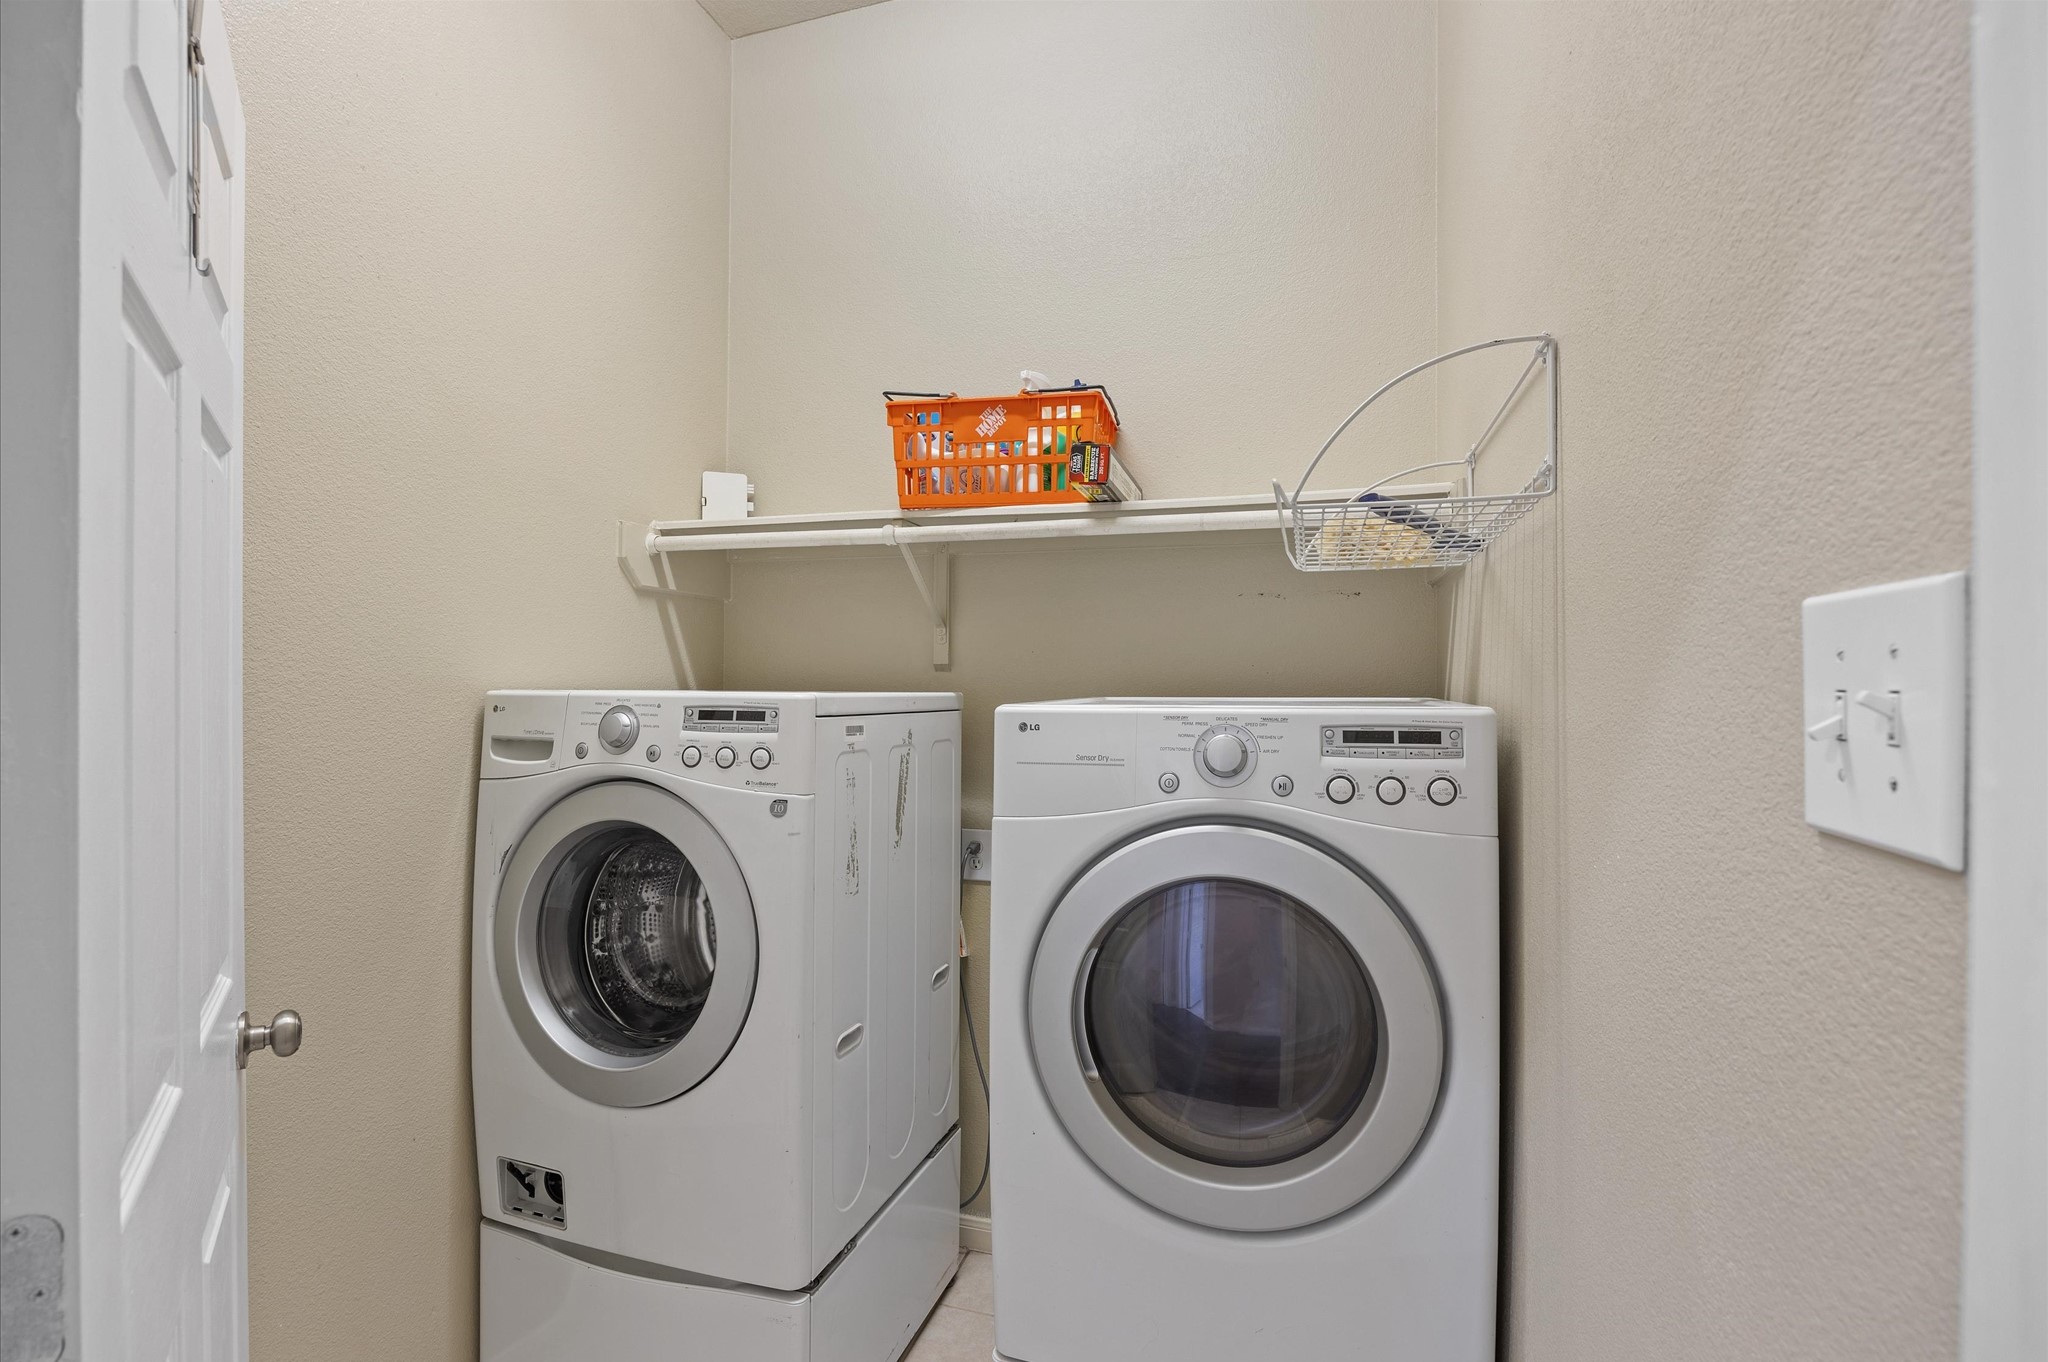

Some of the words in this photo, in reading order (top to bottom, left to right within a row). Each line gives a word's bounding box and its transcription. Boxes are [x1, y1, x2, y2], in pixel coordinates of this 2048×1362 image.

[979, 406, 993, 420] THE
[975, 404, 1007, 438] HOME
[987, 415, 1007, 438] DEPOT
[1029, 723, 1040, 731] LG
[1098, 755, 1110, 763] Dry
[775, 804, 784, 812] 10
